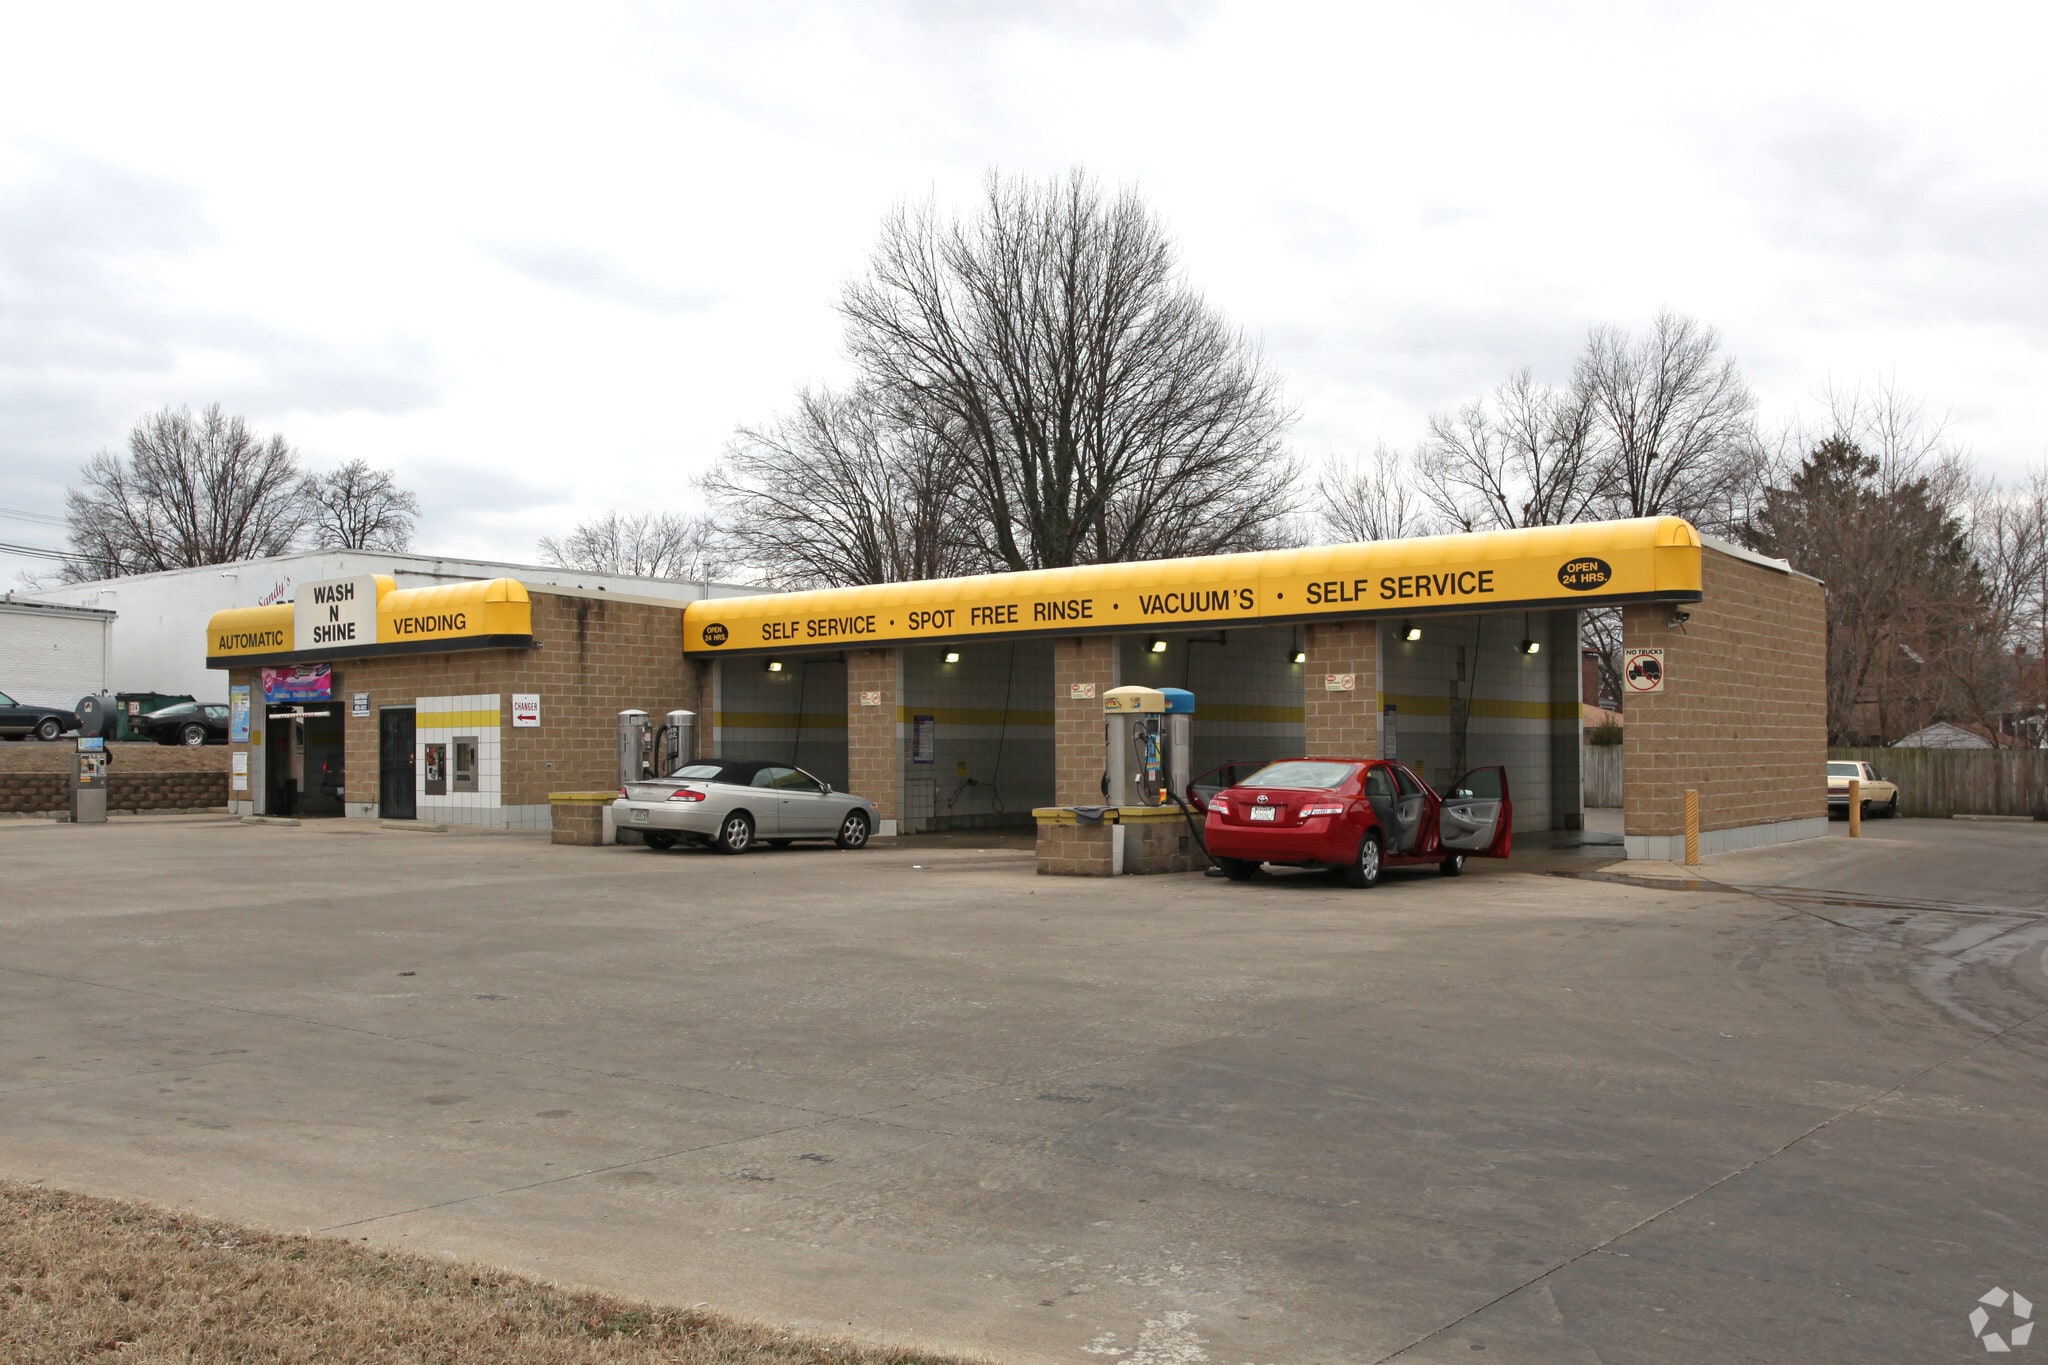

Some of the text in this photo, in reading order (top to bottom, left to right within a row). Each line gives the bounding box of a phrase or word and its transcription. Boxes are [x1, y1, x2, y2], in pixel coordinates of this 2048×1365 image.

[1566, 561, 1598, 573] OPEN
[1306, 570, 1494, 605] SELF SERVICE
[1562, 572, 1608, 585] 24 HRS.
[258, 574, 291, 607] Sandy's
[313, 582, 354, 605] WASH
[1139, 588, 1254, 616] VACUUM'S
[329, 604, 339, 623] N
[393, 612, 466, 635] VENDING
[908, 599, 1093, 631] SPOT FREE RINSE
[313, 622, 356, 644] SHINE
[706, 626, 723, 634] OPEN
[761, 615, 876, 641] SELF SERVICE
[218, 629, 284, 651] AUTOMATIC
[1638, 648, 1663, 656] TRUCKS
[514, 701, 538, 711] CHANGER
